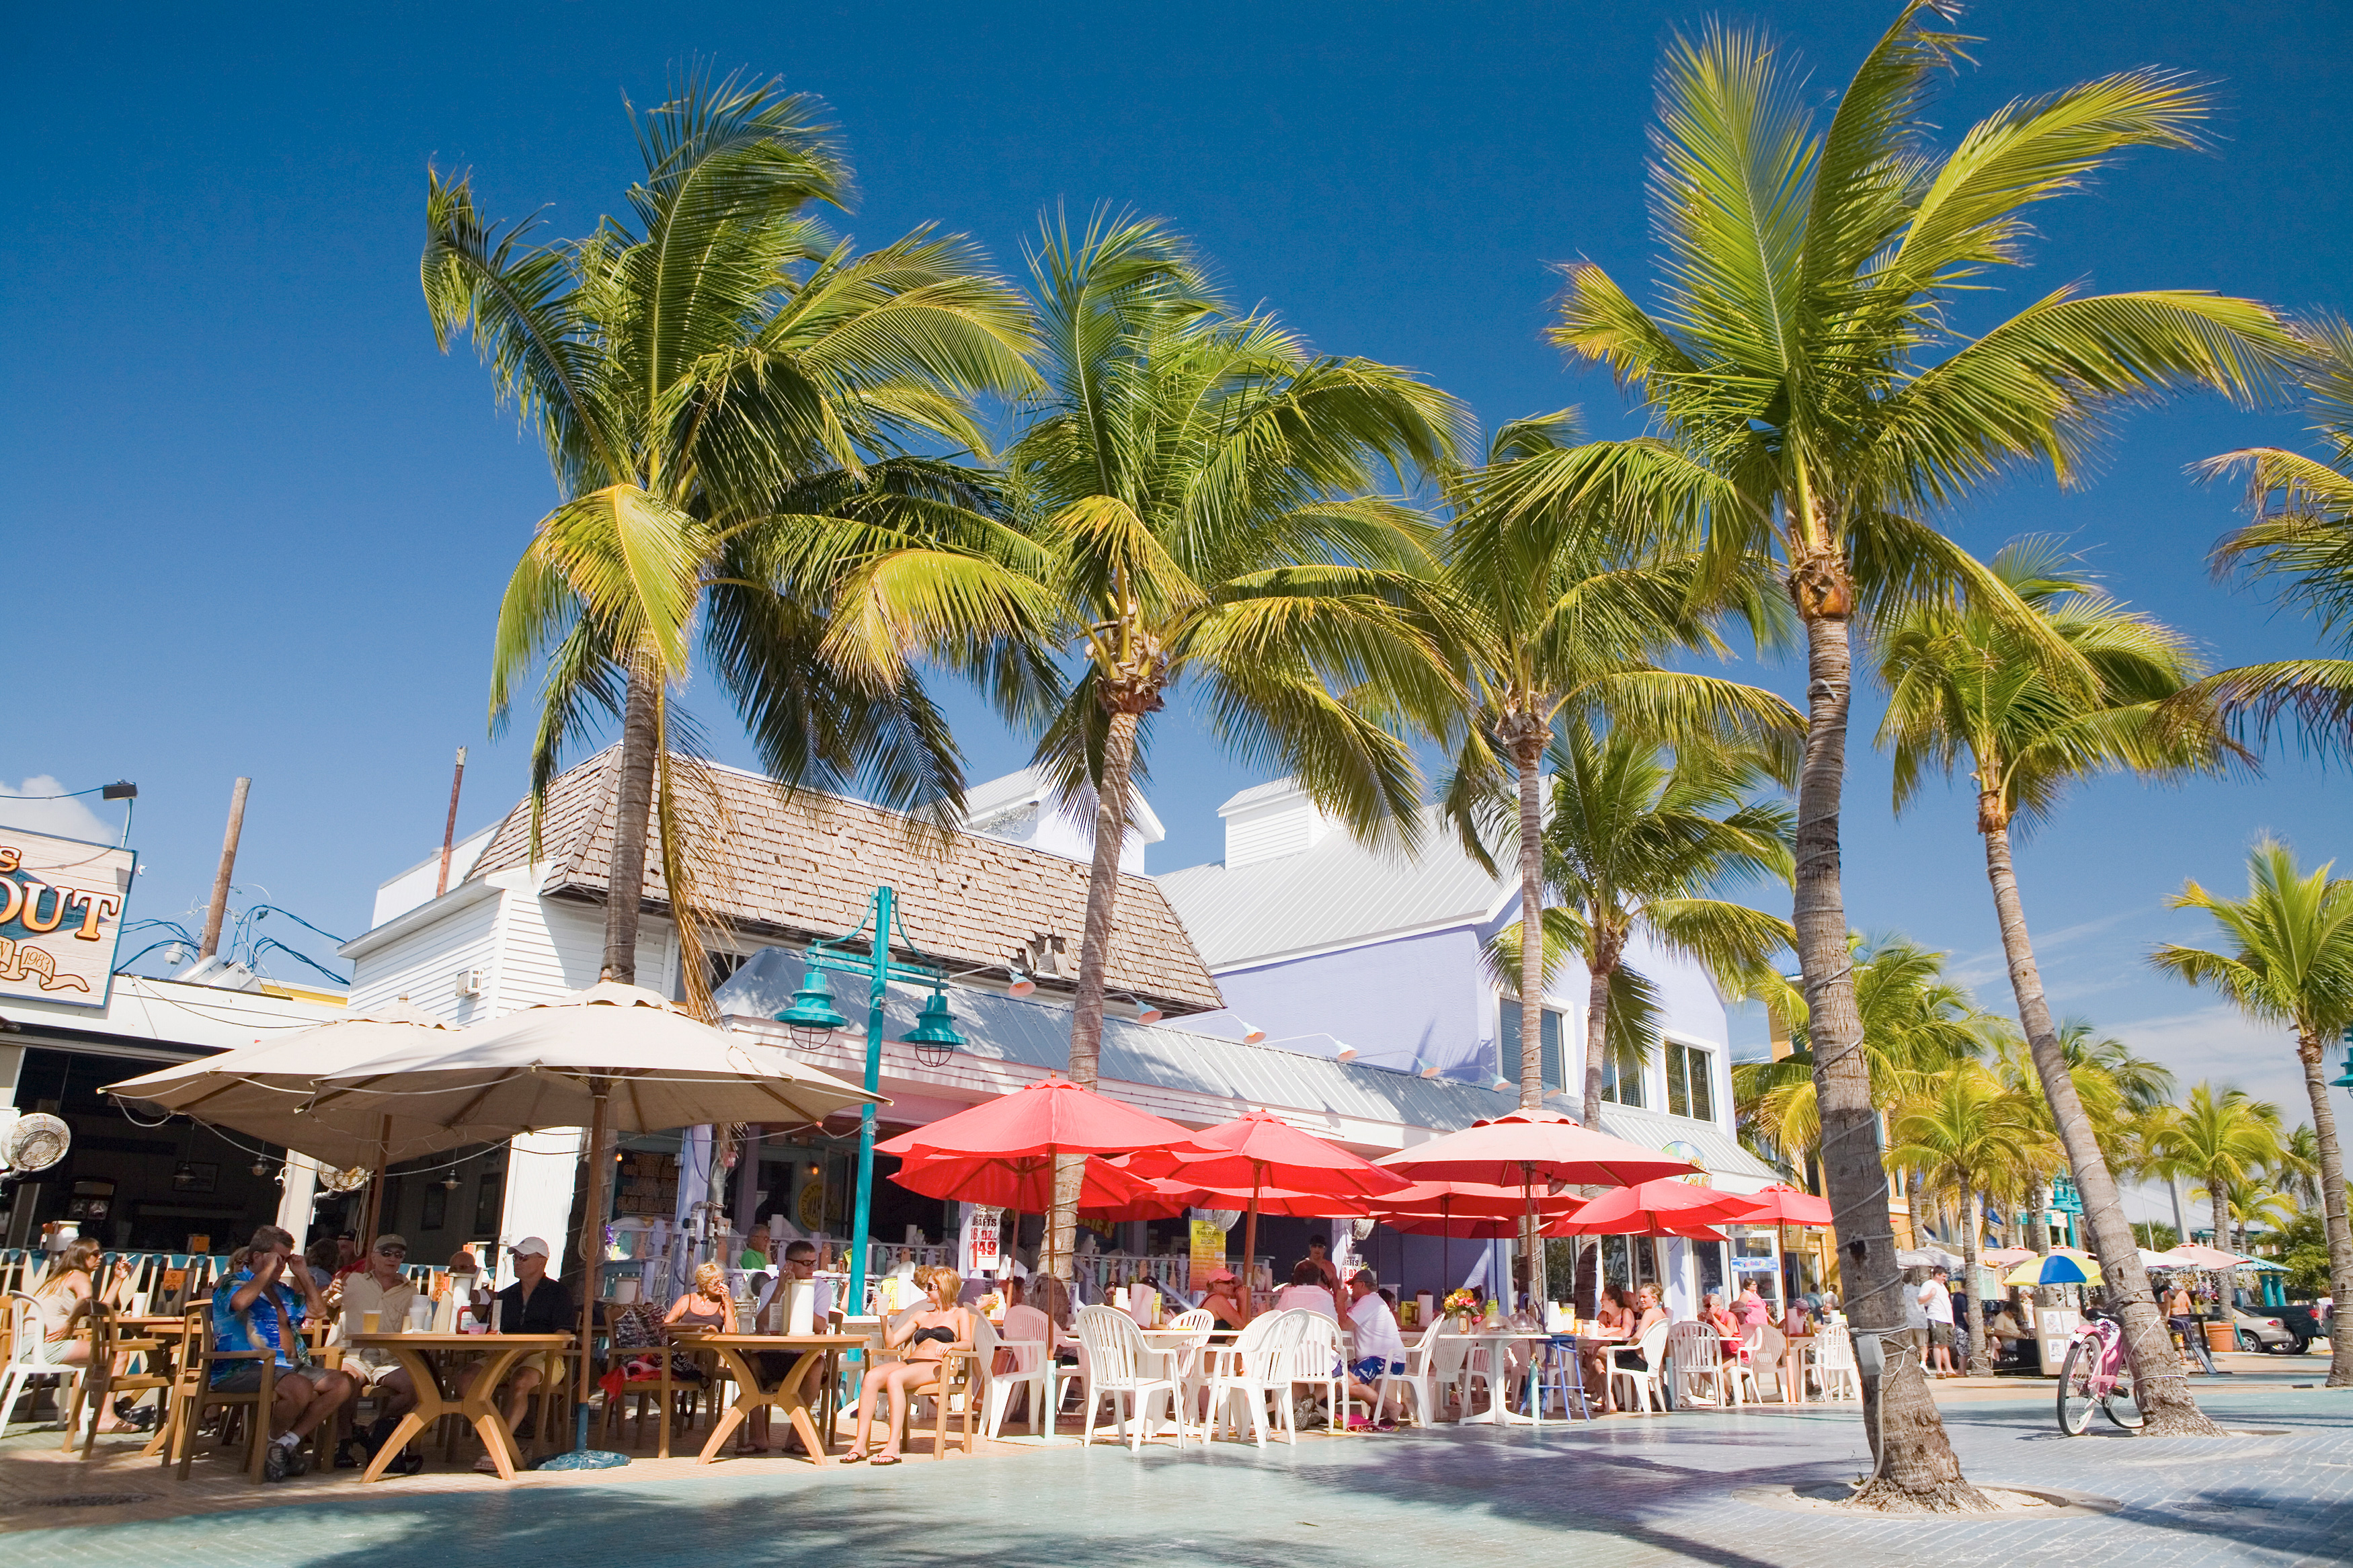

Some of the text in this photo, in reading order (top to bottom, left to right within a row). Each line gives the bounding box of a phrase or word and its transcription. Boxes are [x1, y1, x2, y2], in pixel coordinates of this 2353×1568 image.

[22, 951, 51, 973] 1983
[635, 1155, 663, 1167] BEST
[623, 1164, 639, 1175] ON
[639, 1165, 660, 1177] THE
[636, 1177, 658, 1187] ALL
[623, 1185, 661, 1198] HAPPY
[972, 1216, 997, 1227] DRAFTS
[970, 1227, 978, 1240] 16
